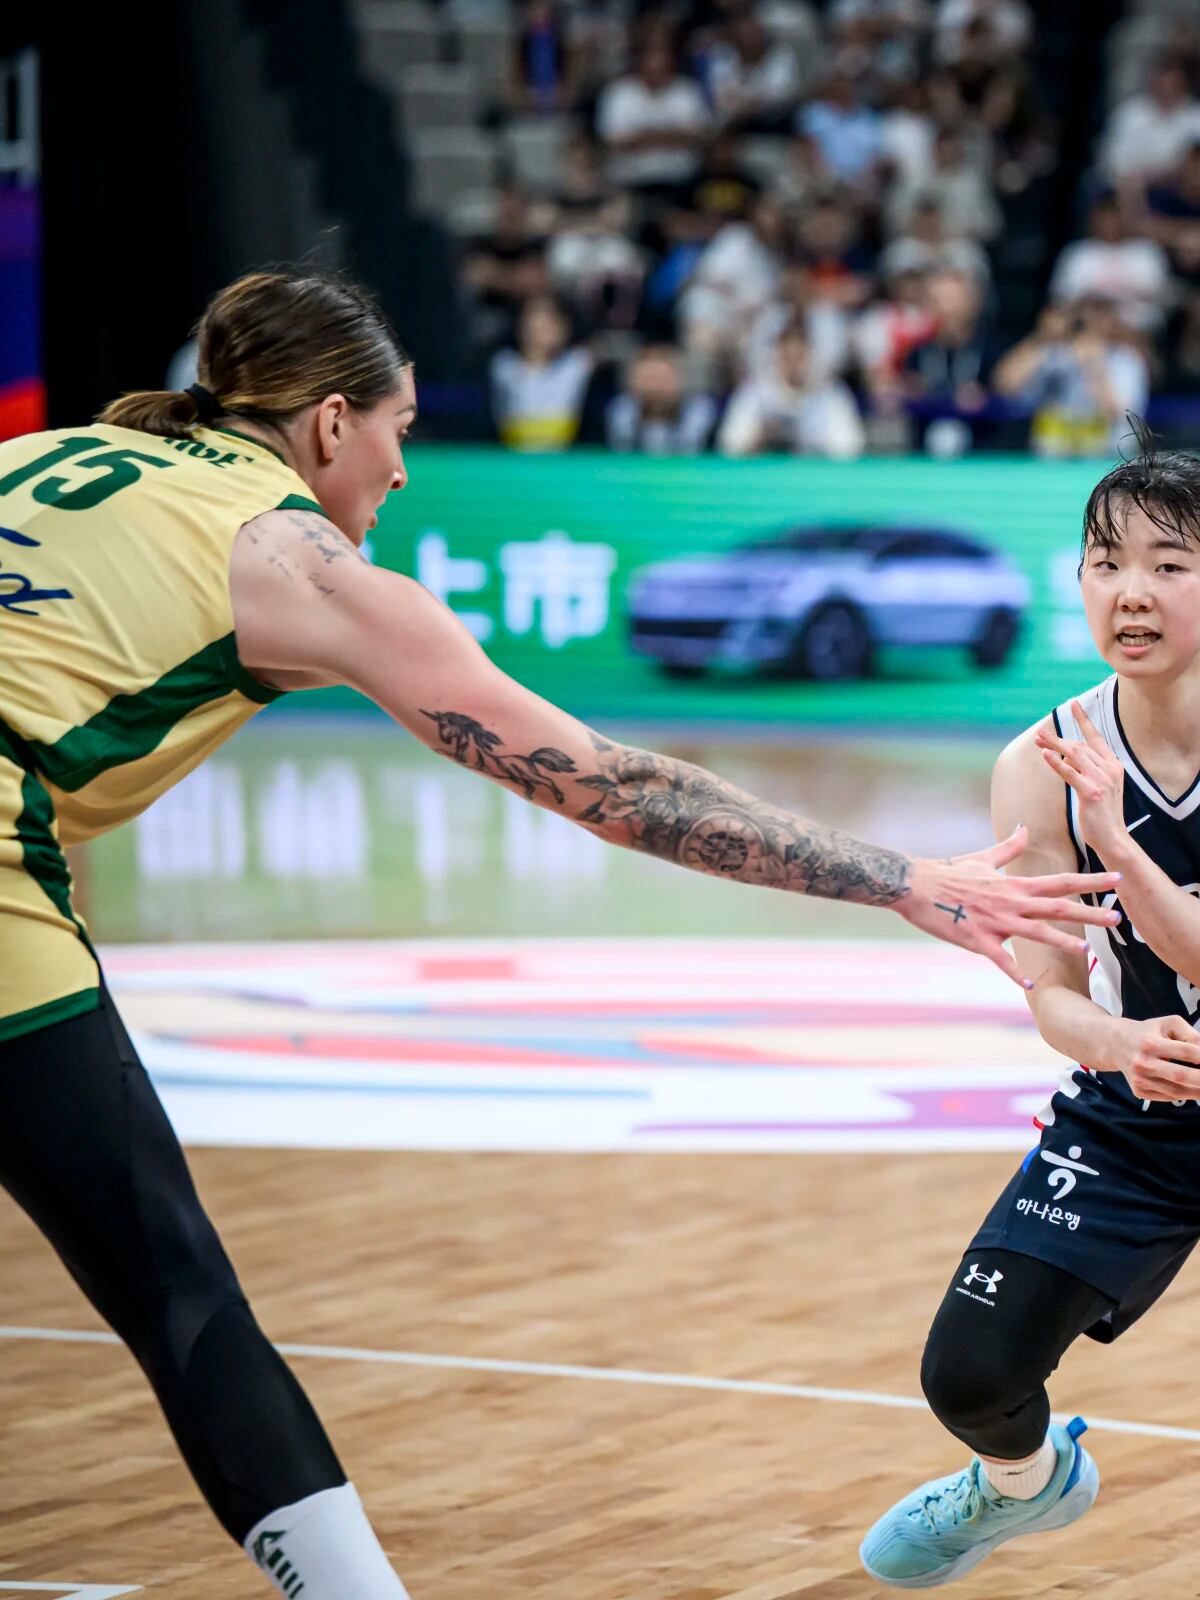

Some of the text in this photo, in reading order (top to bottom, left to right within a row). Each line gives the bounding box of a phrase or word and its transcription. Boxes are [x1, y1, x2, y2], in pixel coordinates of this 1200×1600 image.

[0, 436, 177, 511] 15
[417, 529, 618, 650] 上市
[1016, 1198, 1081, 1231] 하나은행
[970, 1293, 996, 1307] ARMOUR
